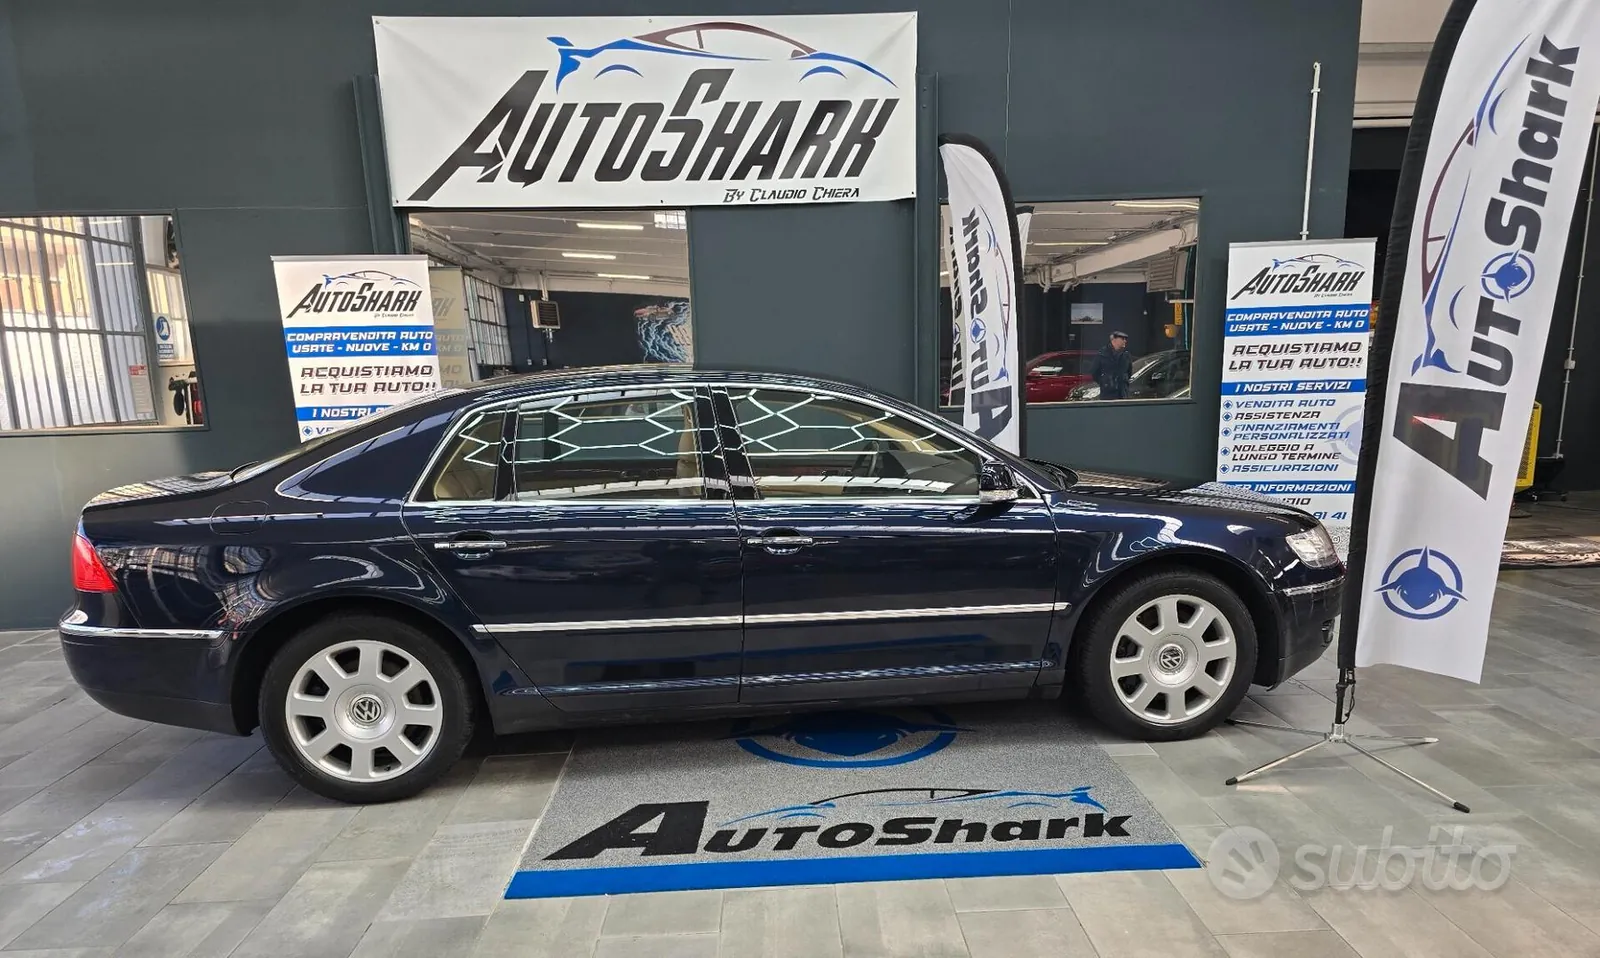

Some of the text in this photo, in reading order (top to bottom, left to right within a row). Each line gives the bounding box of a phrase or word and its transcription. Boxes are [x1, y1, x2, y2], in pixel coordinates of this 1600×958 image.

[749, 188, 807, 202] CLAUDIO
[812, 187, 860, 200] CHIERA
[1227, 309, 1369, 321] COMPRAVENDITA AUTO
[1229, 323, 1270, 332] USATE
[1280, 321, 1323, 330] NUOVE
[1333, 320, 1351, 329] KM
[287, 331, 434, 342] COMPRAVENDITA AUTO
[292, 344, 334, 353] USATE
[345, 342, 390, 352] NUOVE
[401, 342, 420, 351] KM
[1232, 342, 1362, 356] ACQUISTIAMO
[1229, 357, 1363, 371] LA TUA AUTO!!
[300, 365, 433, 379] ACQUISTIAMO
[300, 383, 323, 395] LA
[329, 382, 366, 394] TUA
[373, 381, 437, 393] AUTO!!
[1235, 381, 1352, 392] I NOSTRI SERVIZI
[1235, 399, 1336, 408] VENDITA AUTO
[321, 407, 371, 418] NOSTRI
[1234, 411, 1321, 420] ASSISTENZA
[1233, 422, 1341, 432] FINANZIAMENTI
[1232, 431, 1350, 441] PERSONALIZZATI
[1232, 443, 1315, 453] NOLEGGIO A
[1231, 452, 1342, 461] LUNGO TERMINE
[1231, 464, 1340, 472] ASSICURAZIONI
[1254, 483, 1352, 492] INFORMAZIONI
